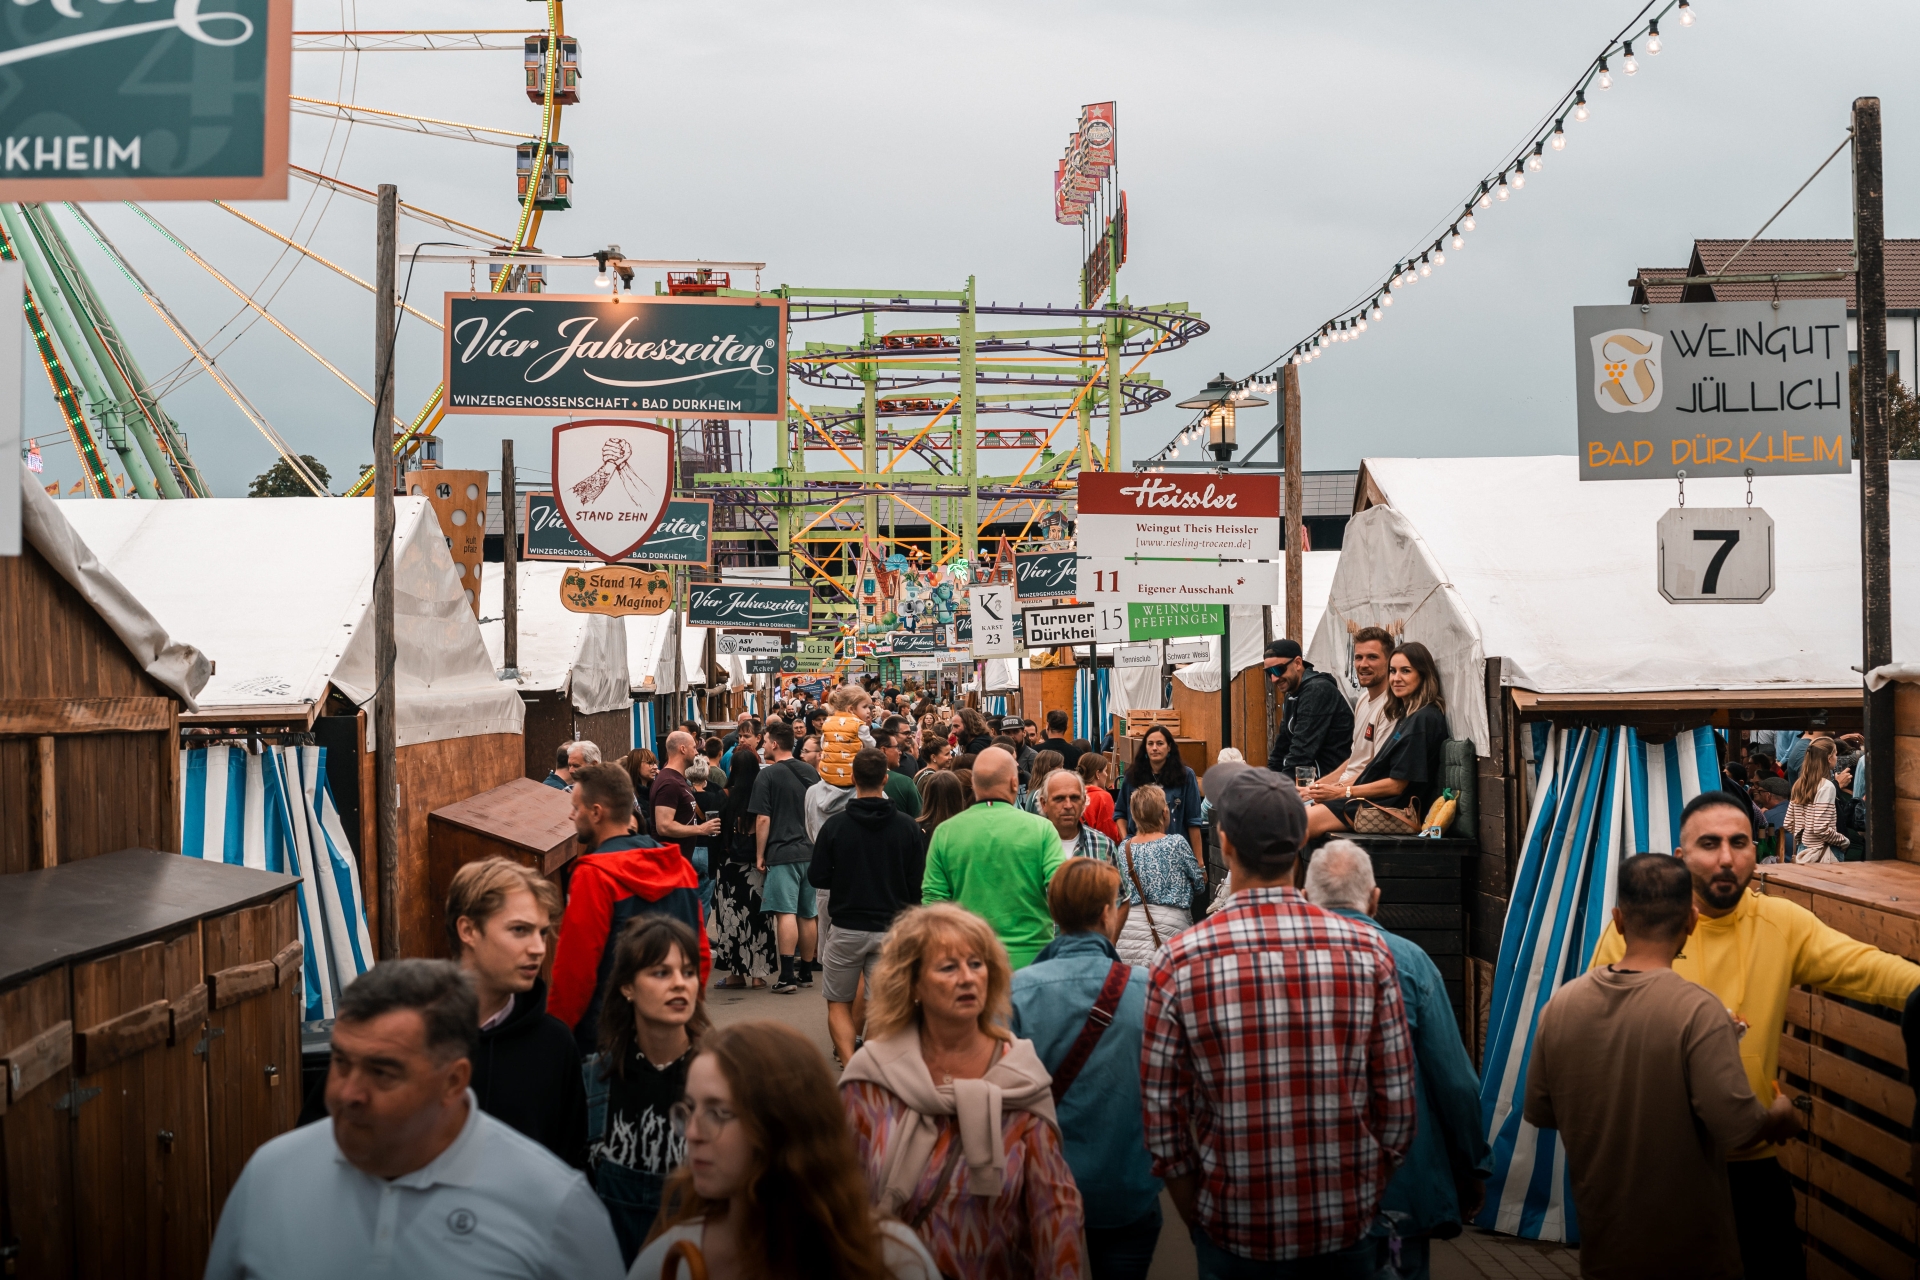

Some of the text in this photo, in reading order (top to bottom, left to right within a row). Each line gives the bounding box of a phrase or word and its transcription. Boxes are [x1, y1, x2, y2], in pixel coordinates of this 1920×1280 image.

[0, 135, 142, 171] KHEIM
[453, 307, 540, 364] Vier
[1669, 321, 1841, 363] WEINGUT
[1675, 371, 1841, 413] JÜLLICH
[453, 394, 742, 411] WINZERGENOSSENSCHAFT BAD DÜRKHEIM
[1588, 430, 1844, 468] BAD DÜRKHEIM
[437, 484, 451, 498] 14
[1119, 478, 1238, 510] Heissler
[530, 505, 567, 532] Vie
[575, 511, 648, 522] STAND ZEHN
[1136, 523, 1259, 535] Weingut Theis Heissler
[465, 536, 477, 545] kult
[463, 544, 478, 554] pfalz
[632, 552, 648, 560] BAD
[1692, 529, 1740, 594] 7
[1016, 557, 1077, 587] Vier Ja
[589, 575, 643, 589] Stand 14
[1093, 570, 1121, 593] 11
[1137, 584, 1235, 596] Eigener Ausschank
[613, 594, 665, 610] Maginot
[690, 588, 722, 609] Vier
[978, 592, 1005, 621] K
[1142, 603, 1208, 616] WEINGUT
[1031, 612, 1095, 626] Turnver
[1100, 607, 1123, 630] 15
[1134, 613, 1219, 629] PFEFFINGEN
[986, 634, 1001, 645] 23
[1031, 626, 1096, 642] Dürkhei
[783, 660, 796, 669] 26
[1121, 655, 1152, 663] Tennisclub
[1167, 652, 1191, 661] Schwarz
